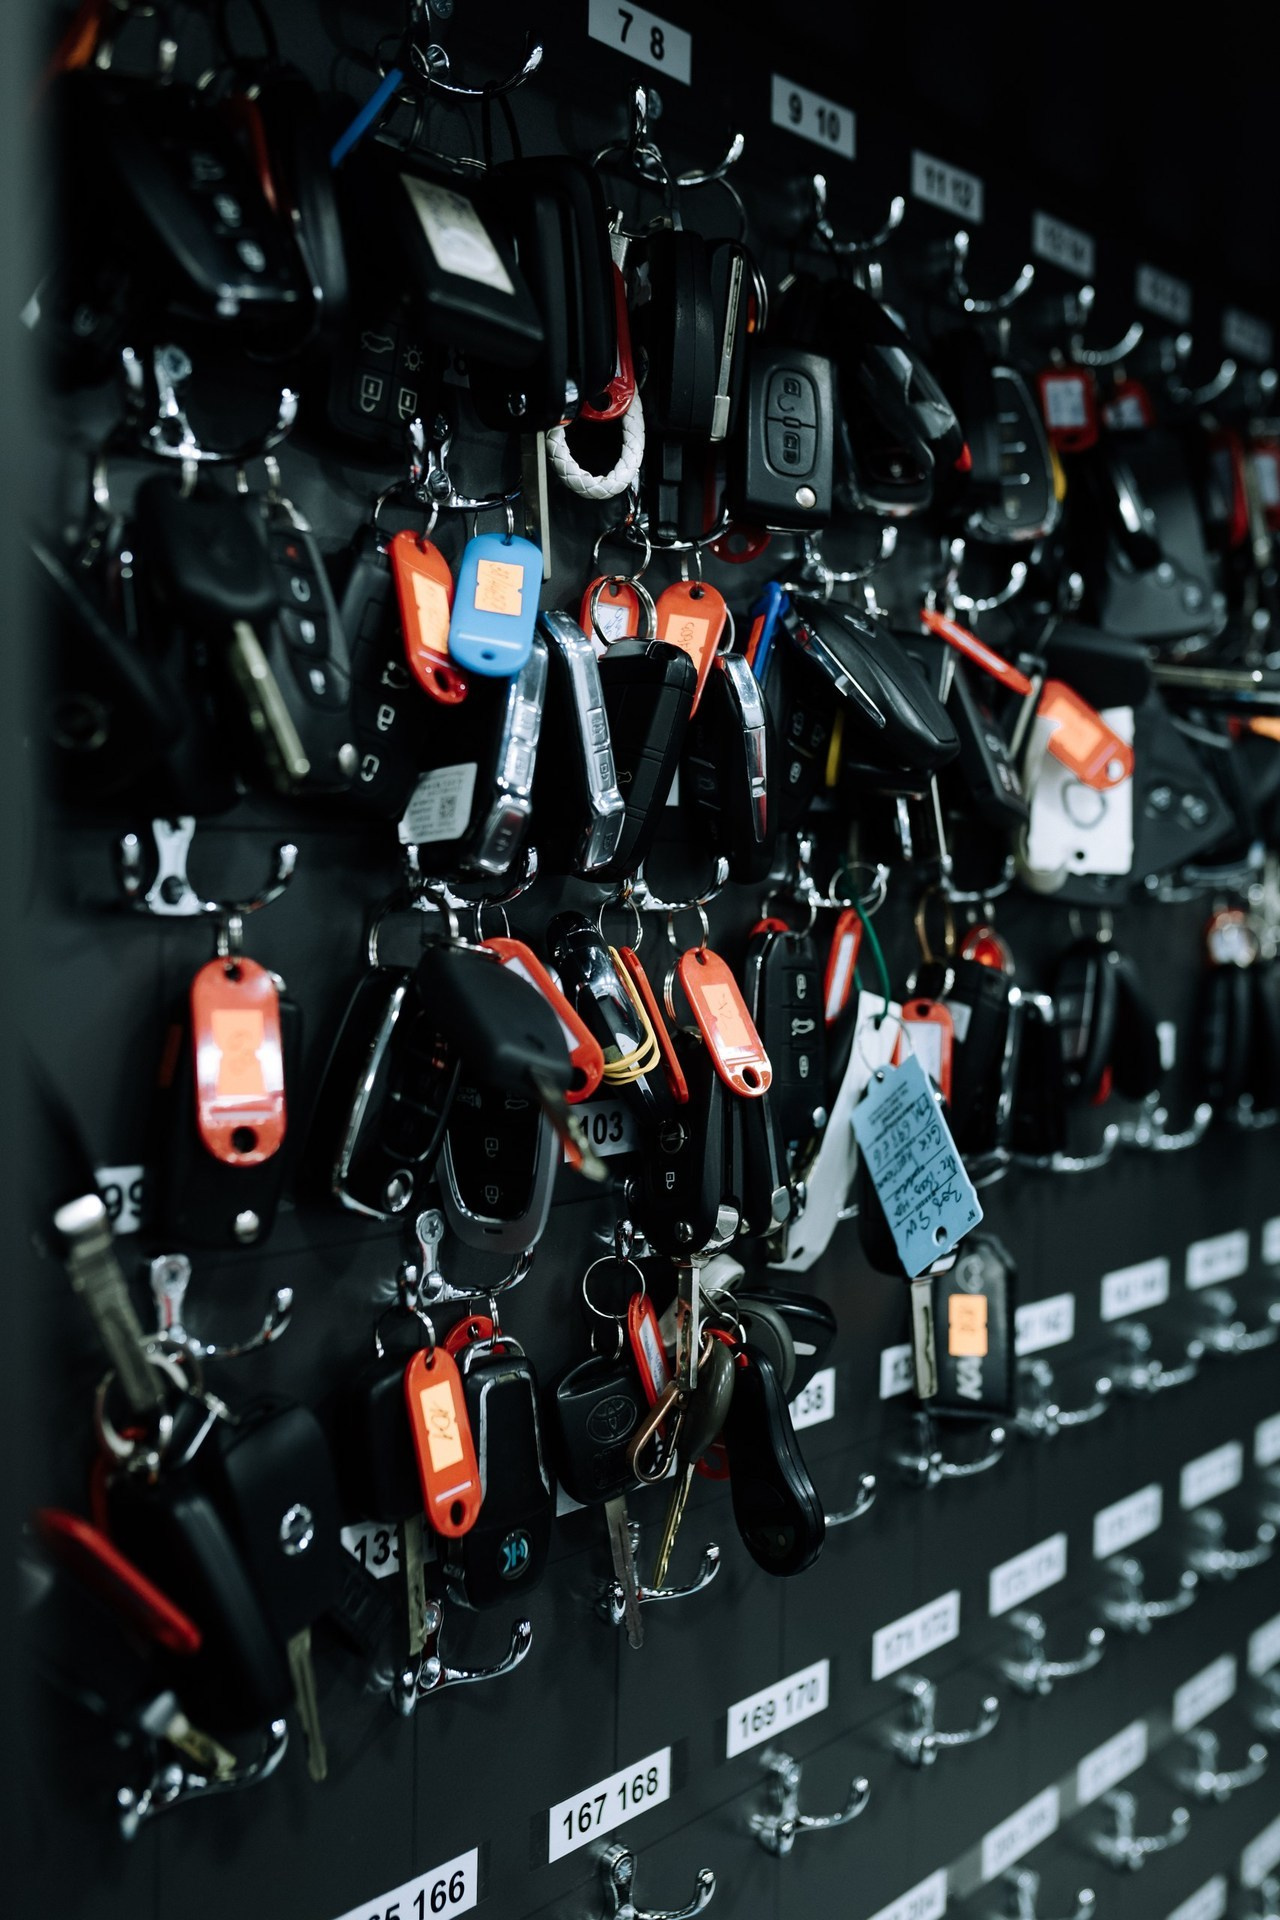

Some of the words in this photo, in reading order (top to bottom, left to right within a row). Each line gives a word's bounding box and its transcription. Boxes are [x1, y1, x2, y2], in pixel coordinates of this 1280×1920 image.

[618, 8, 634, 44] 7
[649, 26, 666, 62] 8
[788, 92, 802, 124] 9
[815, 105, 842, 143] 10
[579, 1111, 624, 1145] 103
[354, 1530, 399, 1567] 13
[739, 1698, 777, 1738] 169
[785, 1677, 819, 1715] 170
[563, 1793, 607, 1840] 167
[618, 1766, 658, 1811] 168
[413, 1870, 465, 1920] 166
